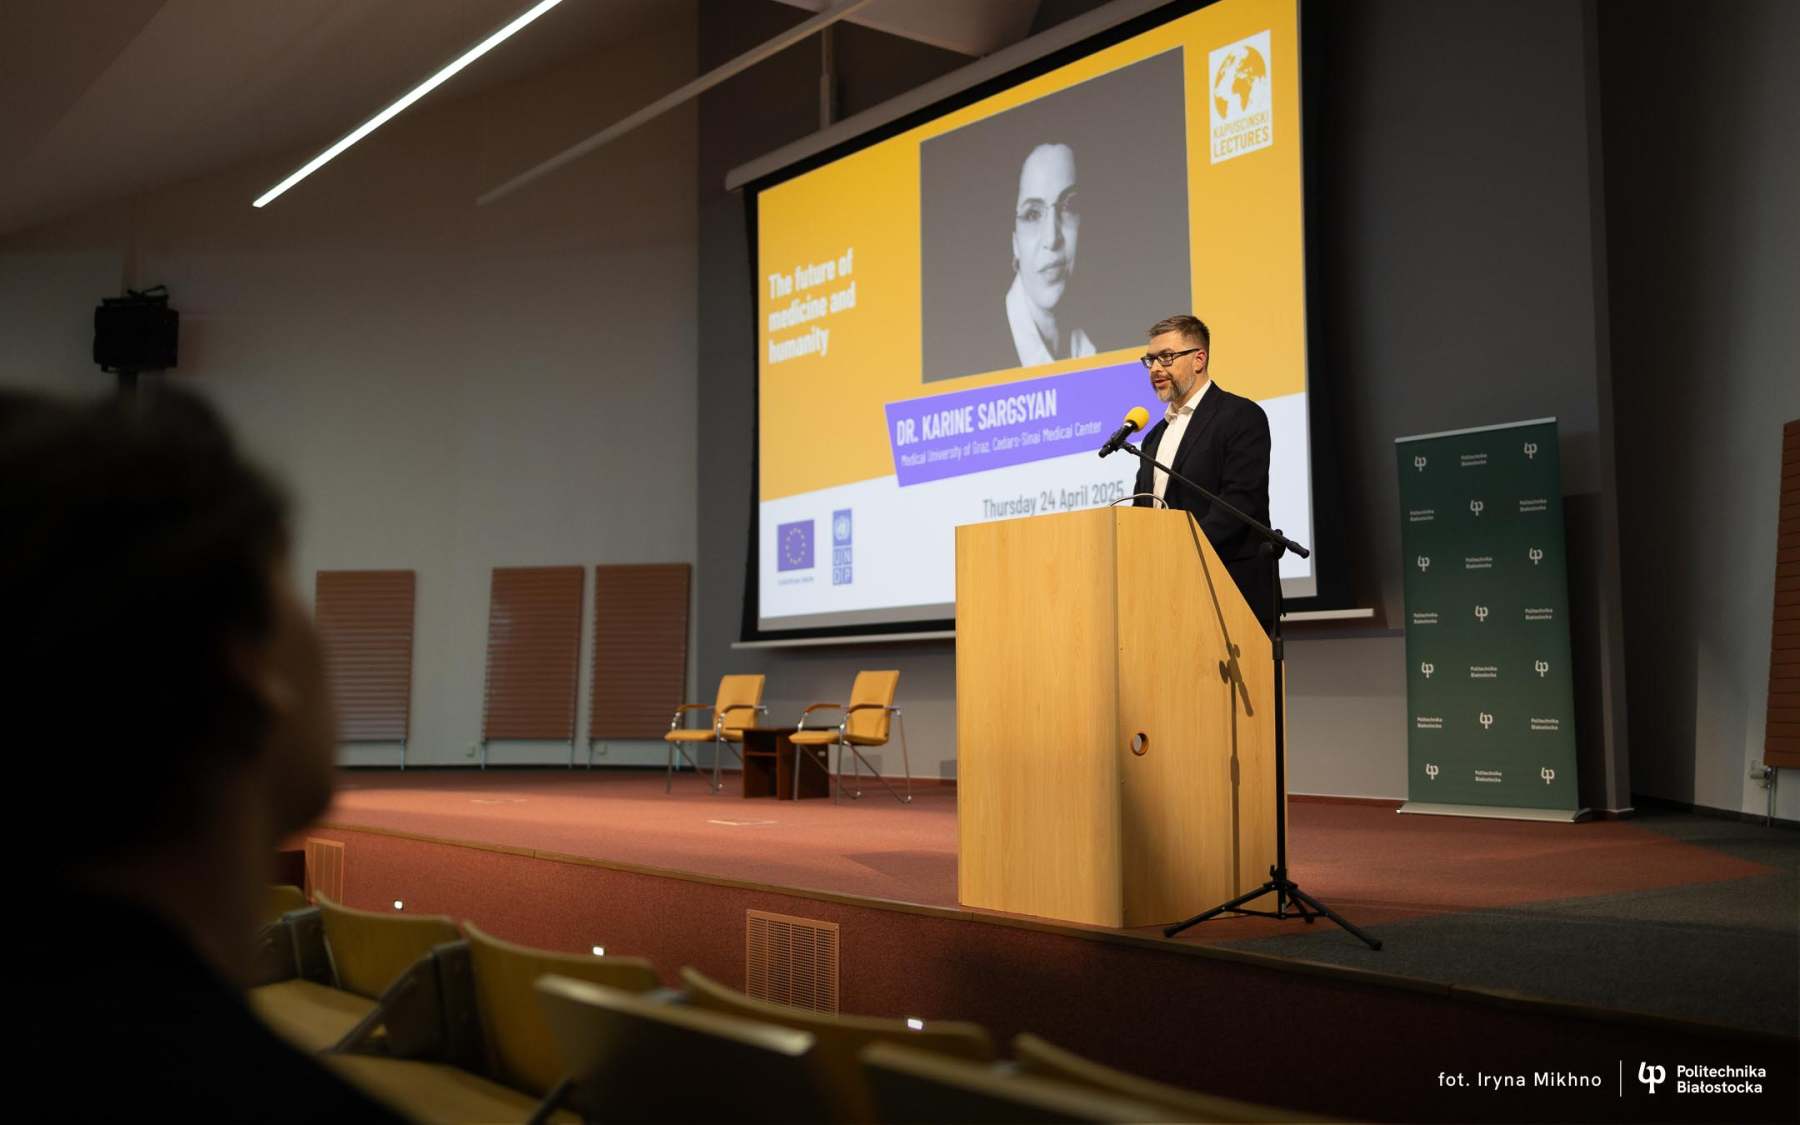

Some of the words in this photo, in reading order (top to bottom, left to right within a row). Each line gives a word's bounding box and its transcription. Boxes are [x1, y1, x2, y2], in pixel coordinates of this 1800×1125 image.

[1213, 126, 1269, 158] LECTURES
[768, 272, 793, 301] The
[794, 259, 836, 291] future
[838, 247, 854, 278] of
[768, 294, 828, 333] medicine
[830, 280, 857, 314] and
[768, 325, 830, 365] humanity
[896, 418, 919, 447] DR.
[922, 405, 975, 441] KARINE
[978, 388, 1058, 431] SARGSYAN
[901, 451, 927, 467] Medical
[928, 445, 962, 463] University
[963, 443, 971, 456] of
[1042, 424, 1073, 442] Medical
[1075, 420, 1102, 437] Center
[983, 494, 1037, 519] Thursday
[1040, 490, 1056, 512] 24
[1059, 486, 1089, 511] April
[1092, 480, 1125, 505] 2025
